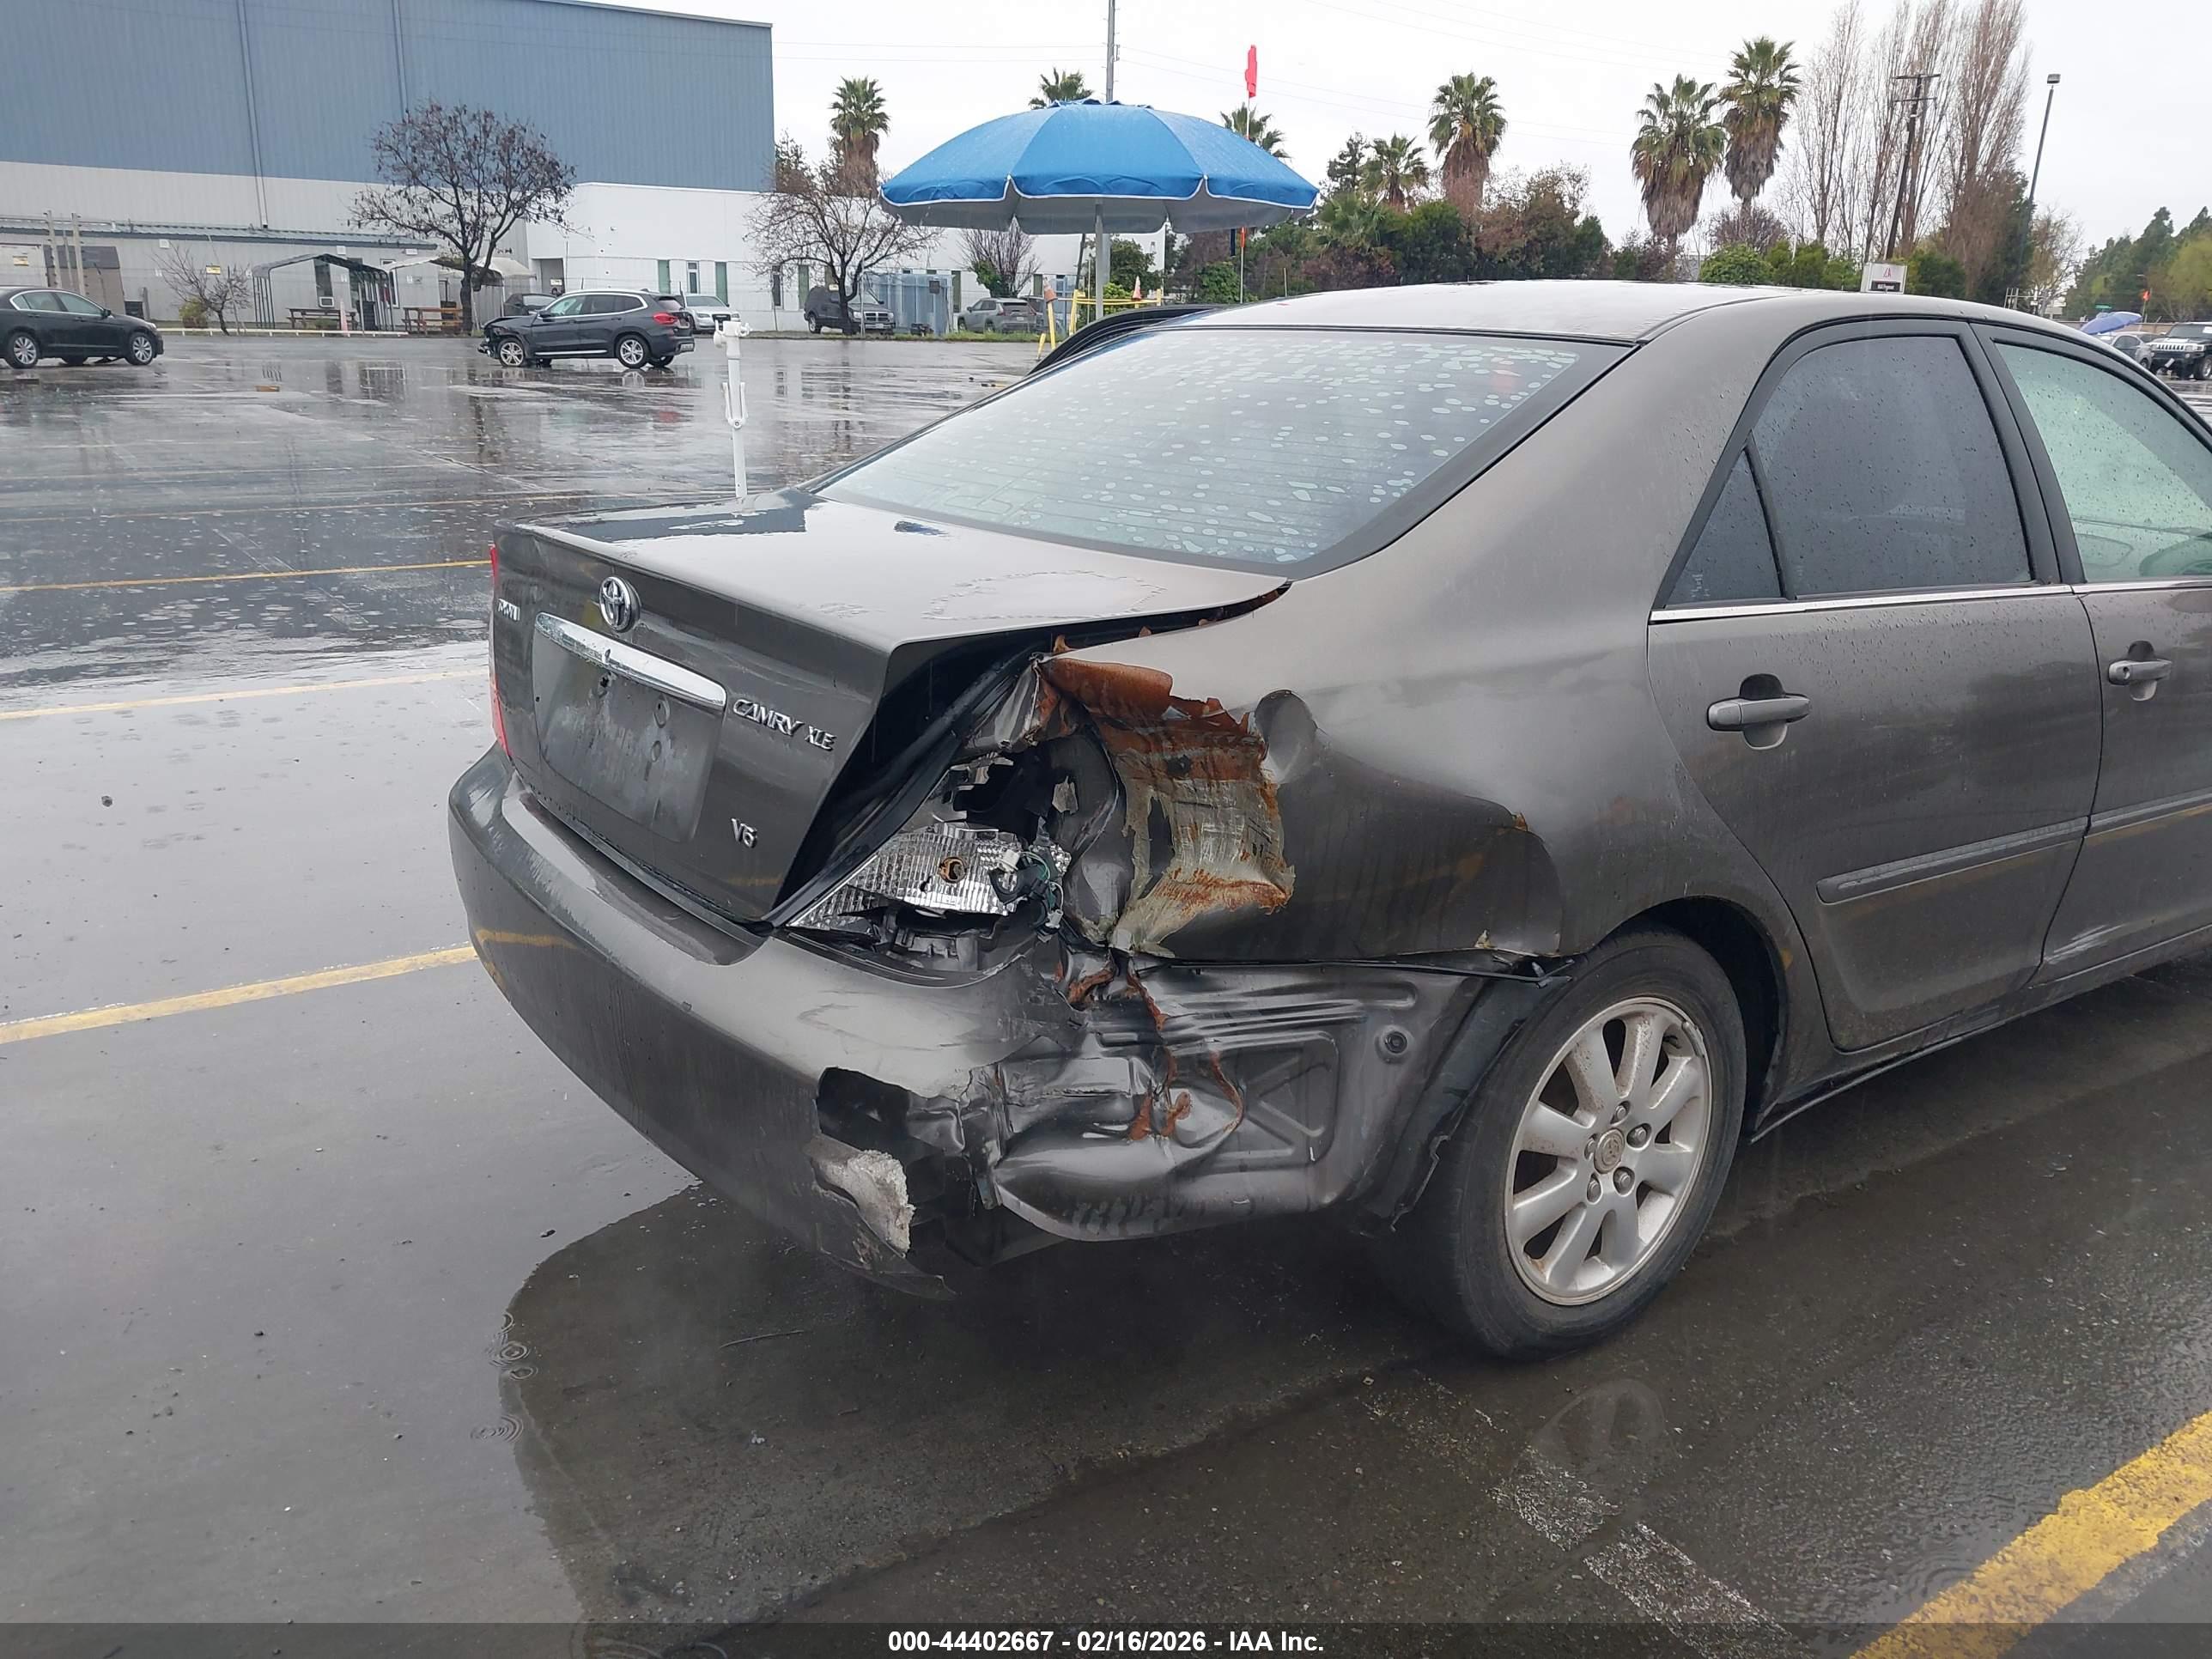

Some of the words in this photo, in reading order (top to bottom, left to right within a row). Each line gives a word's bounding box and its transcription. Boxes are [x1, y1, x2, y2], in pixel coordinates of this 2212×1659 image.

[733, 699, 805, 736] CAMRY
[805, 725, 837, 750] XLE
[731, 817, 756, 848] V6
